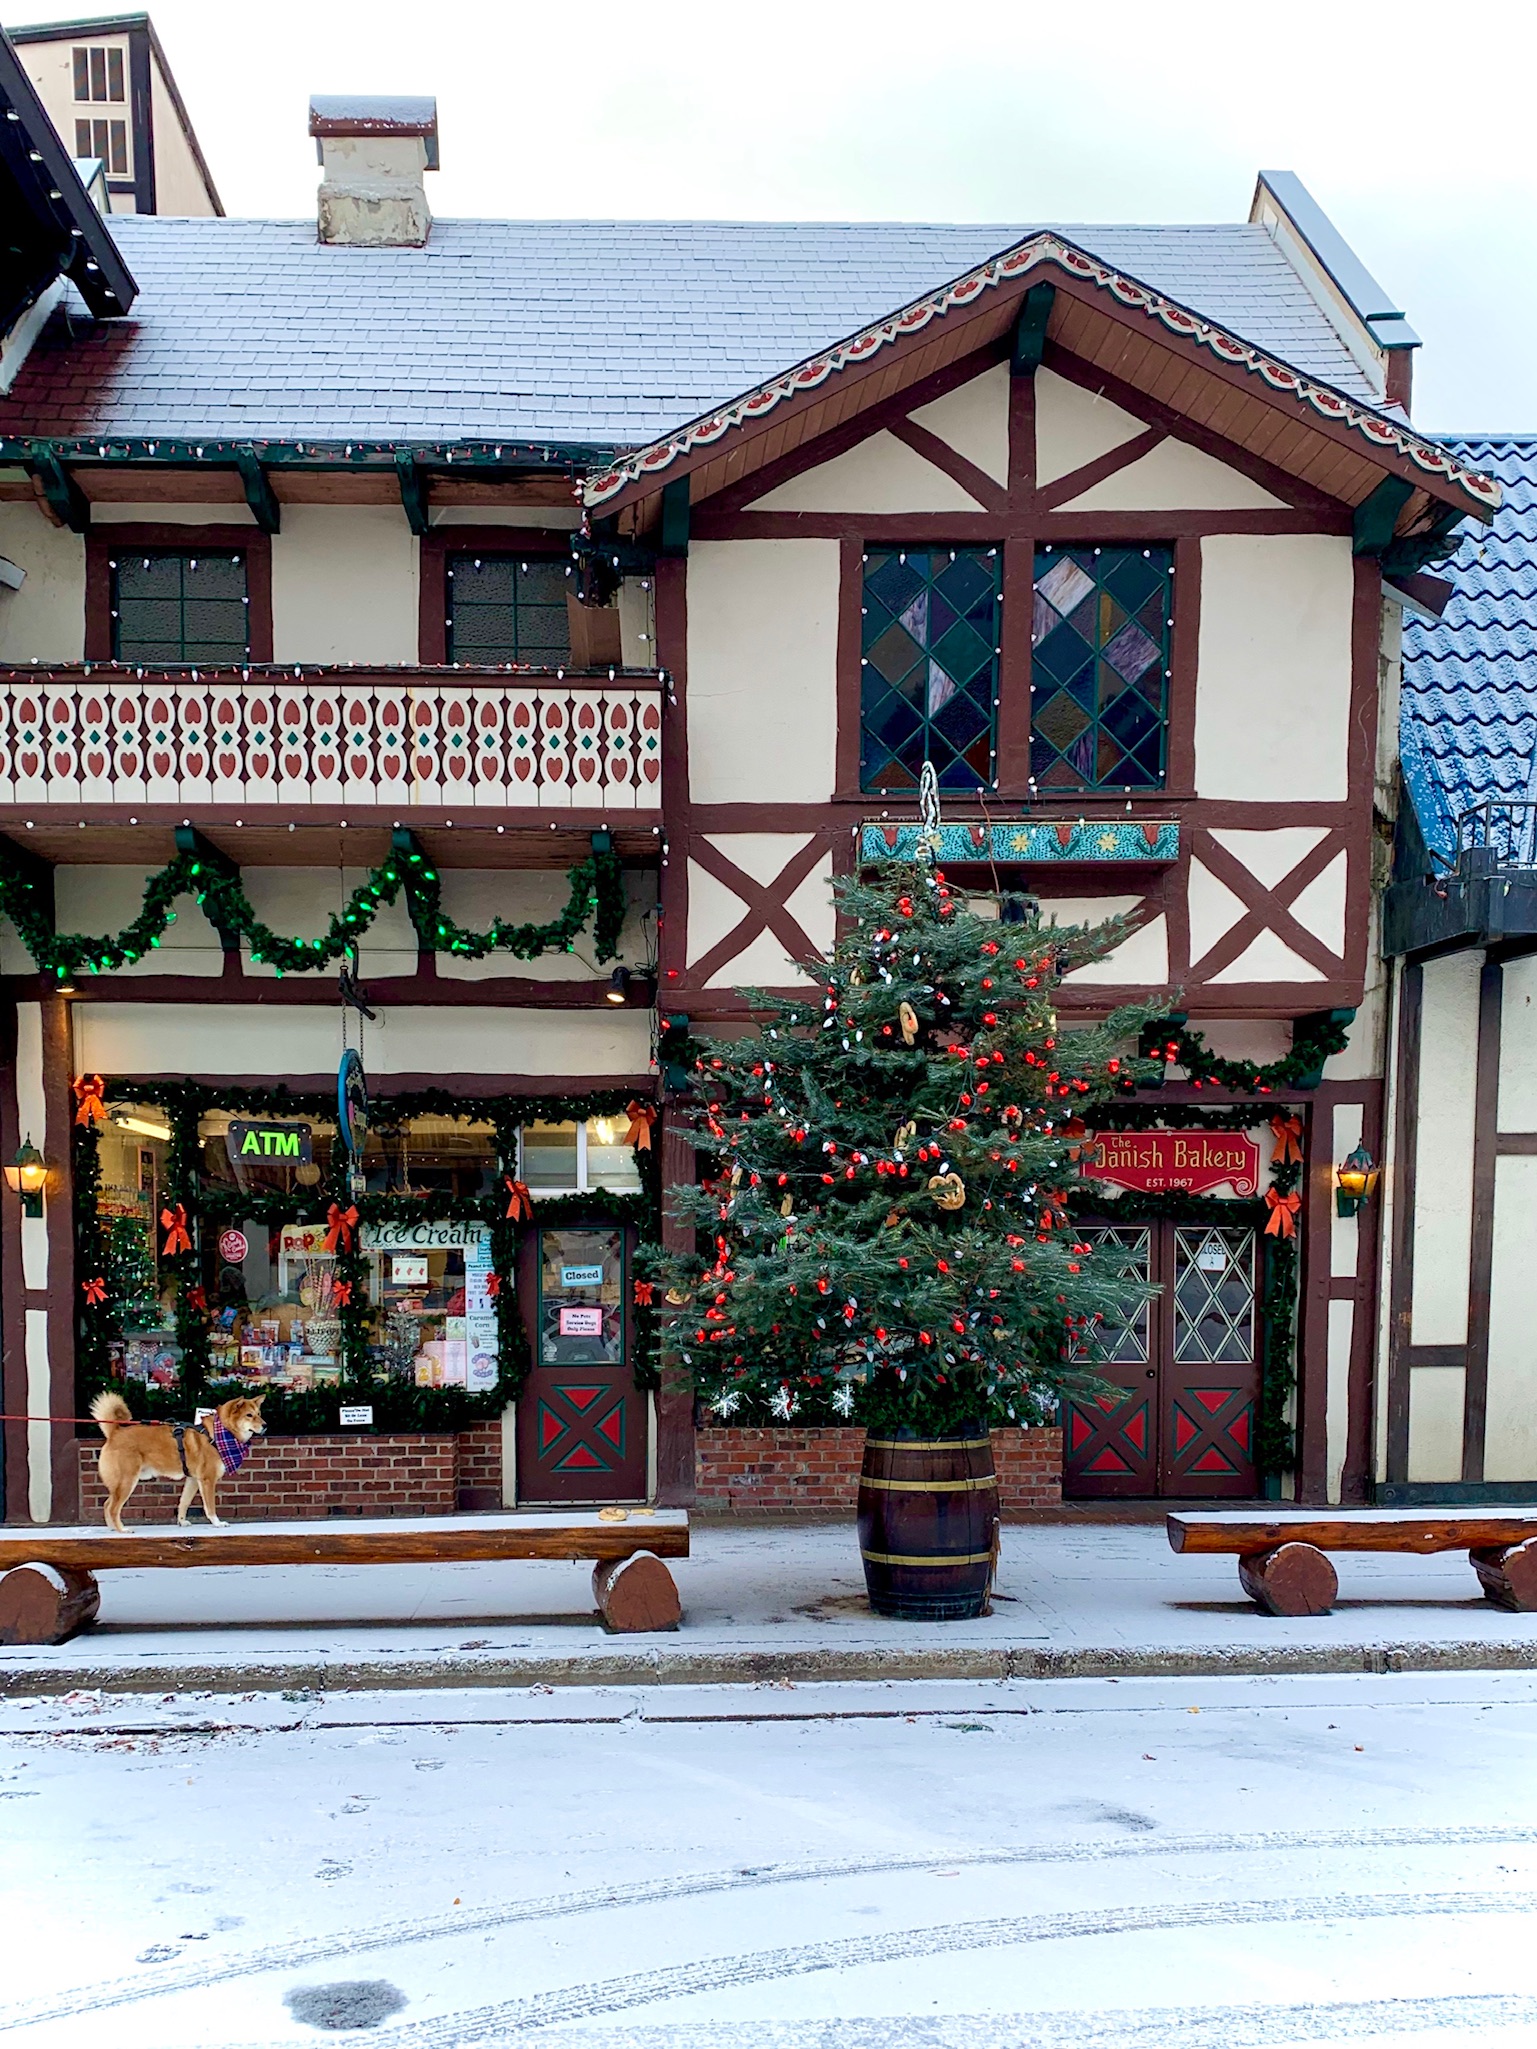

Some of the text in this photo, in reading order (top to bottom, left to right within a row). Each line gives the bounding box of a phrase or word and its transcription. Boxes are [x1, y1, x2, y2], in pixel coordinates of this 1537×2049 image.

[241, 1131, 300, 1156] ATM
[1111, 1136, 1131, 1148] The
[1095, 1140, 1245, 1172] Danish Bakery
[1146, 1178, 1193, 1187] EST. 1967
[371, 1224, 483, 1244] Ice Cream
[1201, 1244, 1226, 1254] LOSED
[565, 1270, 599, 1281] Closed
